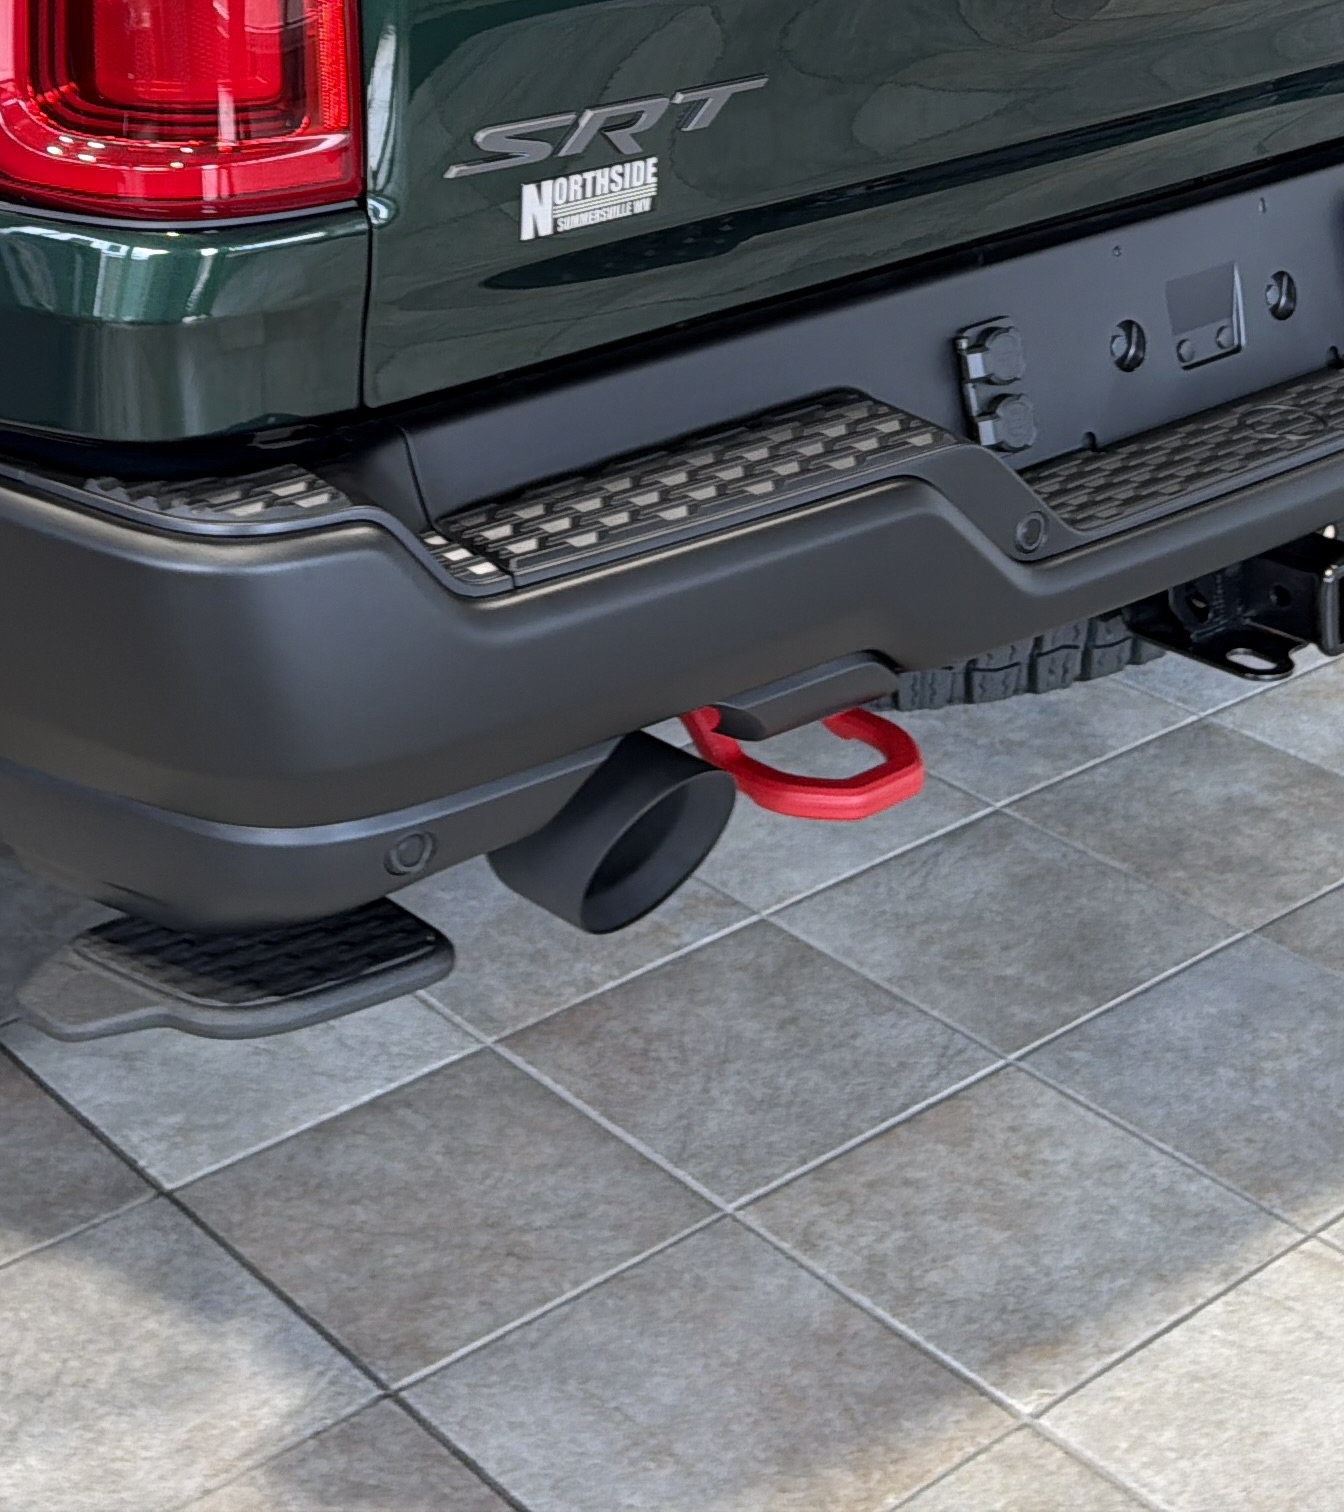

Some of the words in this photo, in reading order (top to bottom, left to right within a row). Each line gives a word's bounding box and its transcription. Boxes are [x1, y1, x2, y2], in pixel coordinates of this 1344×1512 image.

[443, 73, 769, 179] SRT
[520, 156, 658, 241] NORTHSIDE
[556, 201, 632, 233] SUMMERSVILLE
